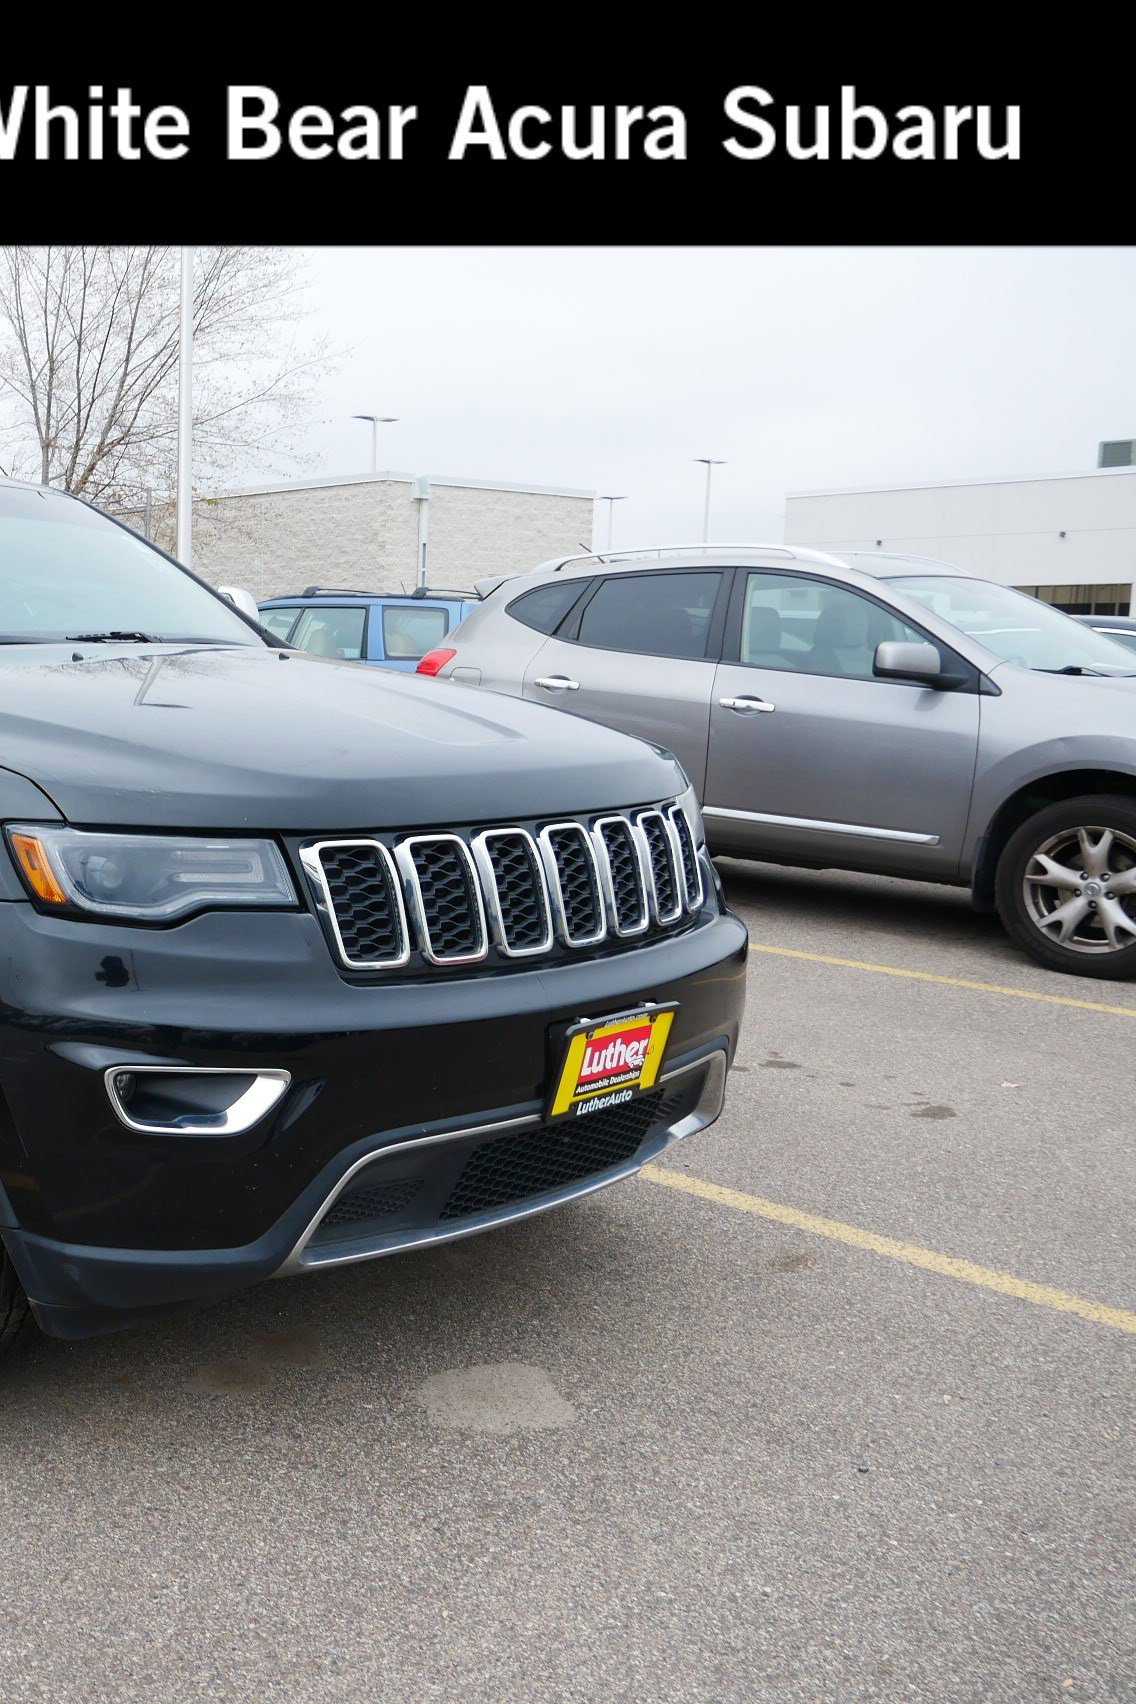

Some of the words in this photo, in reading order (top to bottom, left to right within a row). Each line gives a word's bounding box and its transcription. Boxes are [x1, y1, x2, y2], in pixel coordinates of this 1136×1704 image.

[580, 1038, 649, 1076] Luther
[575, 1077, 609, 1093] Automobile
[609, 1070, 641, 1084] Dealerships
[576, 1089, 633, 1115] LutherAuto
